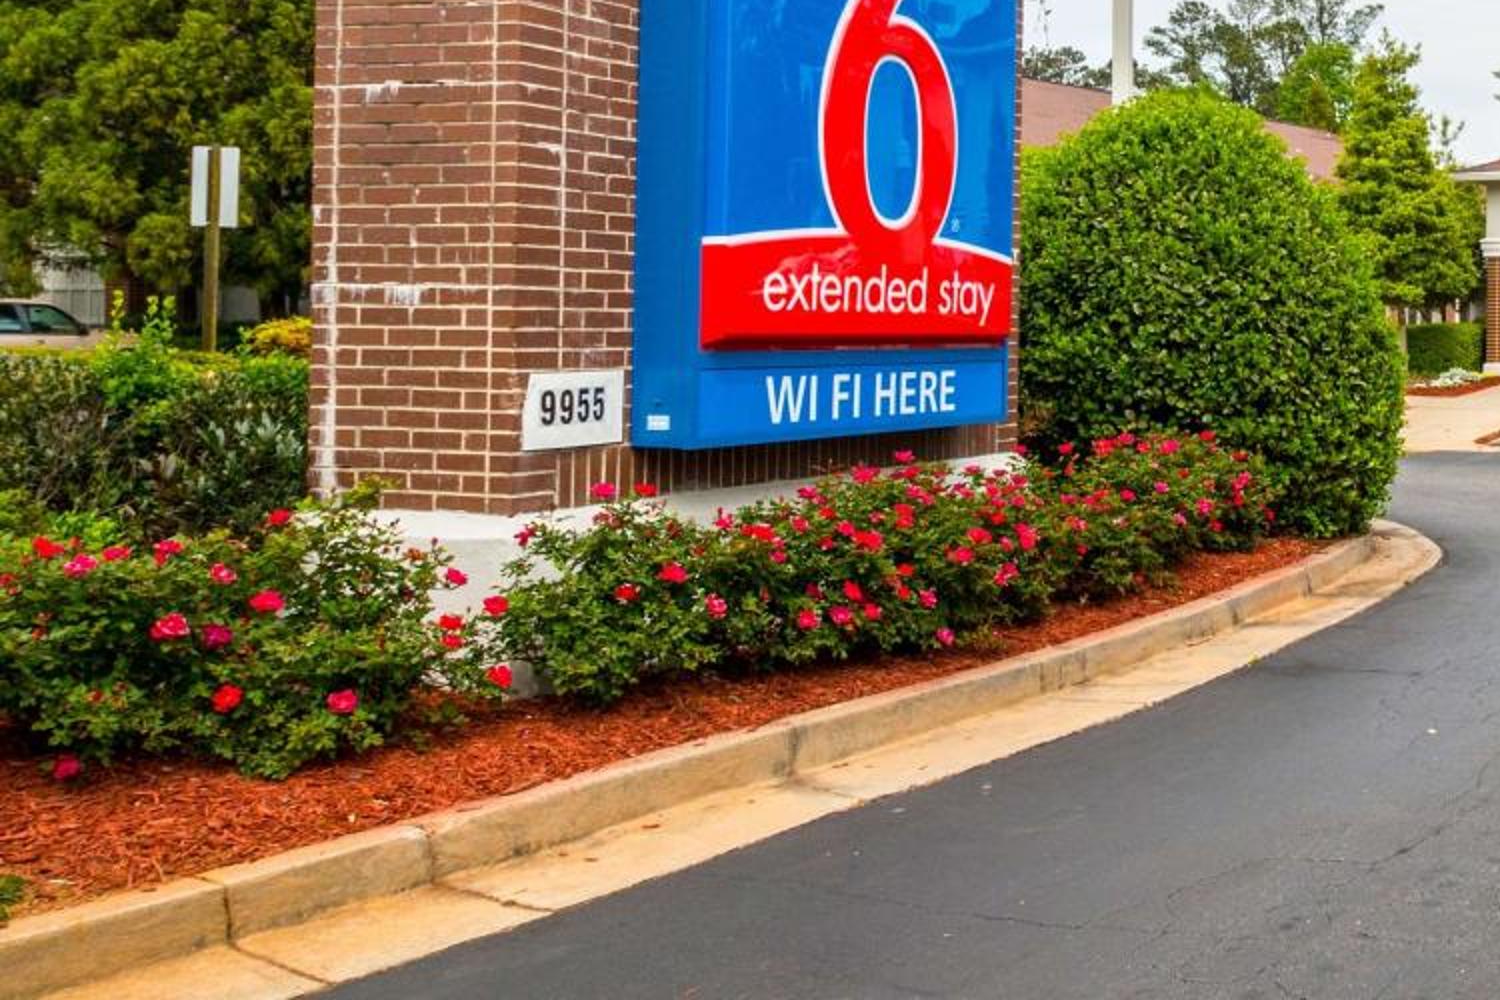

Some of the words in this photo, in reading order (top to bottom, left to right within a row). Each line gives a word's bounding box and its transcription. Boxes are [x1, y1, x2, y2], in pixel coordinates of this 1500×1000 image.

[762, 262, 928, 315] extended
[937, 269, 996, 328] stay
[541, 387, 605, 426] 9955
[765, 374, 819, 425] WI
[831, 372, 862, 420] FI
[873, 369, 957, 417] HERE
